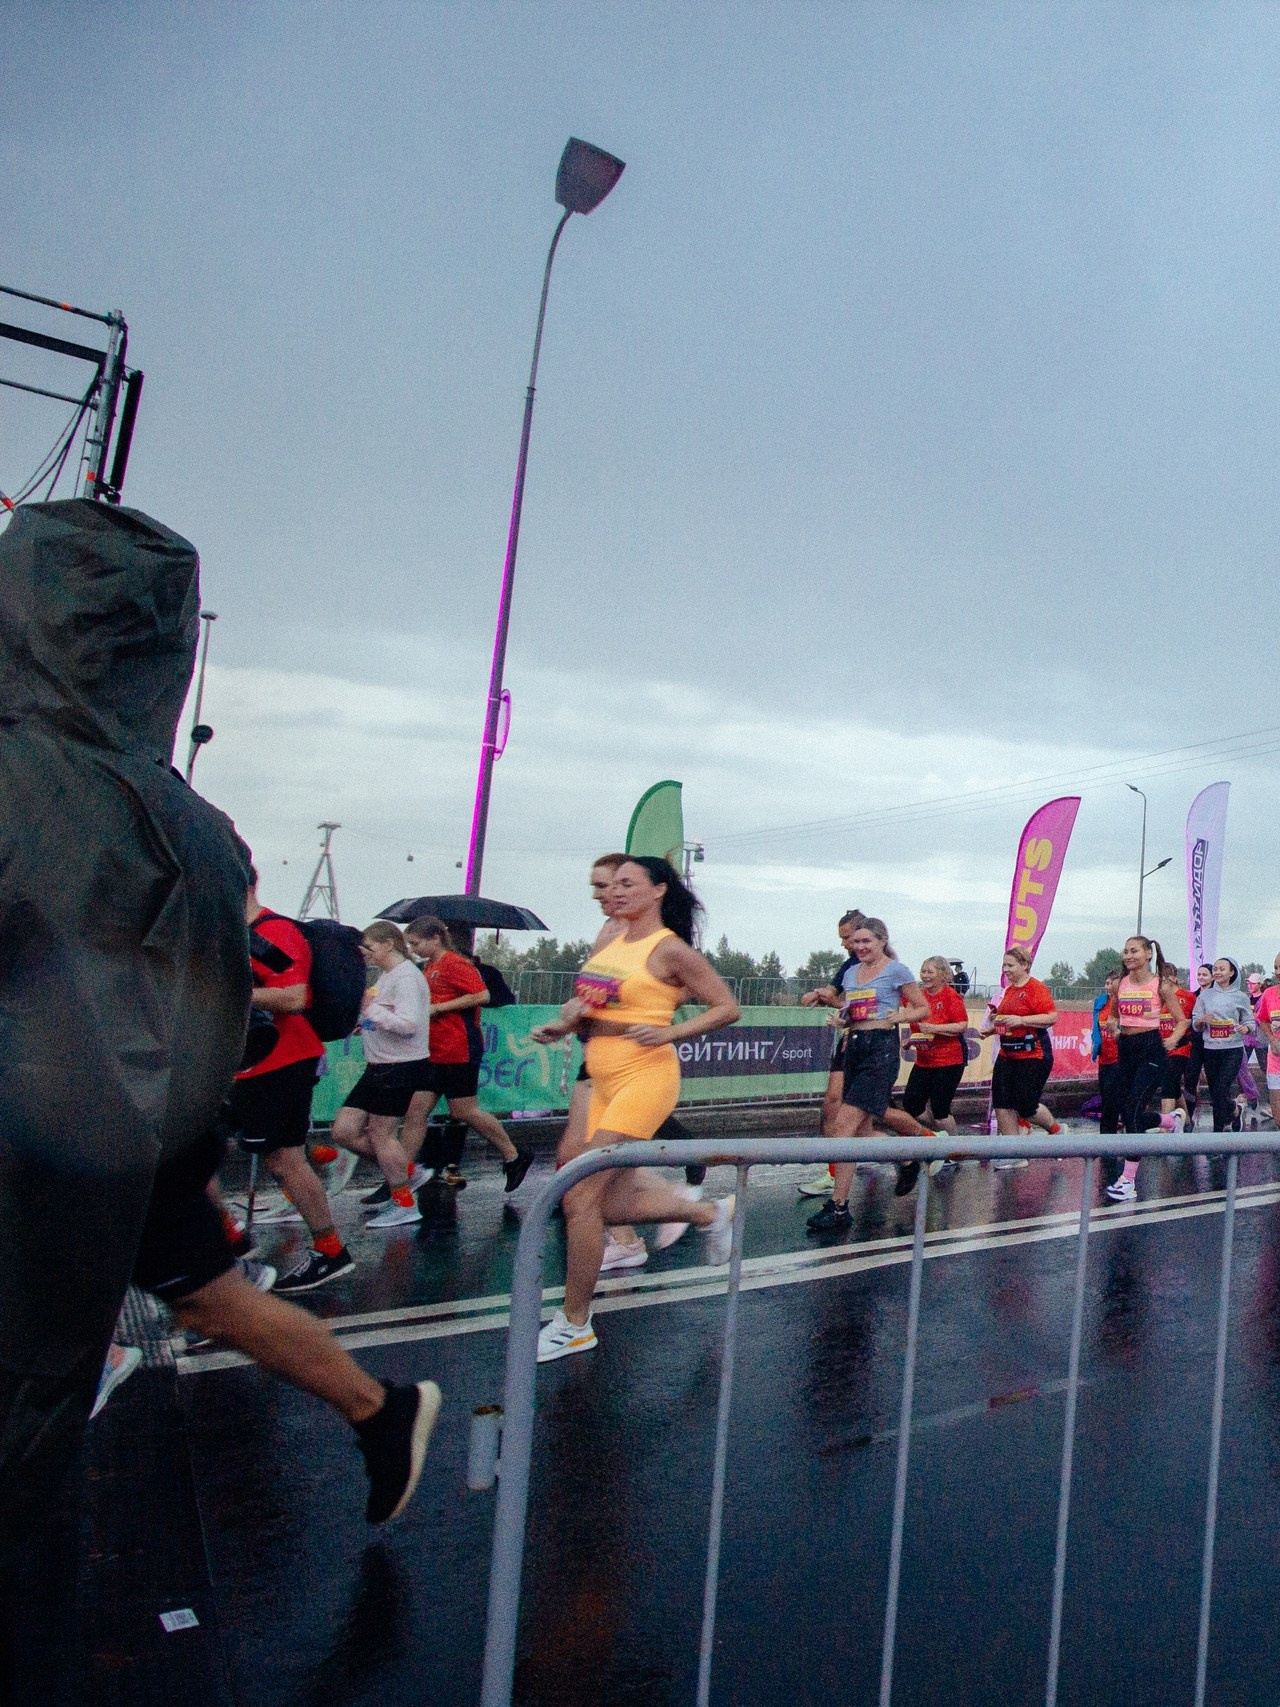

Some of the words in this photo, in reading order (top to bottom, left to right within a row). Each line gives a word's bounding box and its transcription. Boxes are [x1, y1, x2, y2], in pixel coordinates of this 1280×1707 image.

[1010, 838, 1053, 951] UTS
[1120, 1004, 1143, 1015] 2189
[1159, 1023, 1173, 1032] 126
[1211, 1029, 1228, 1038] 2301
[782, 1047, 812, 1061] sport
